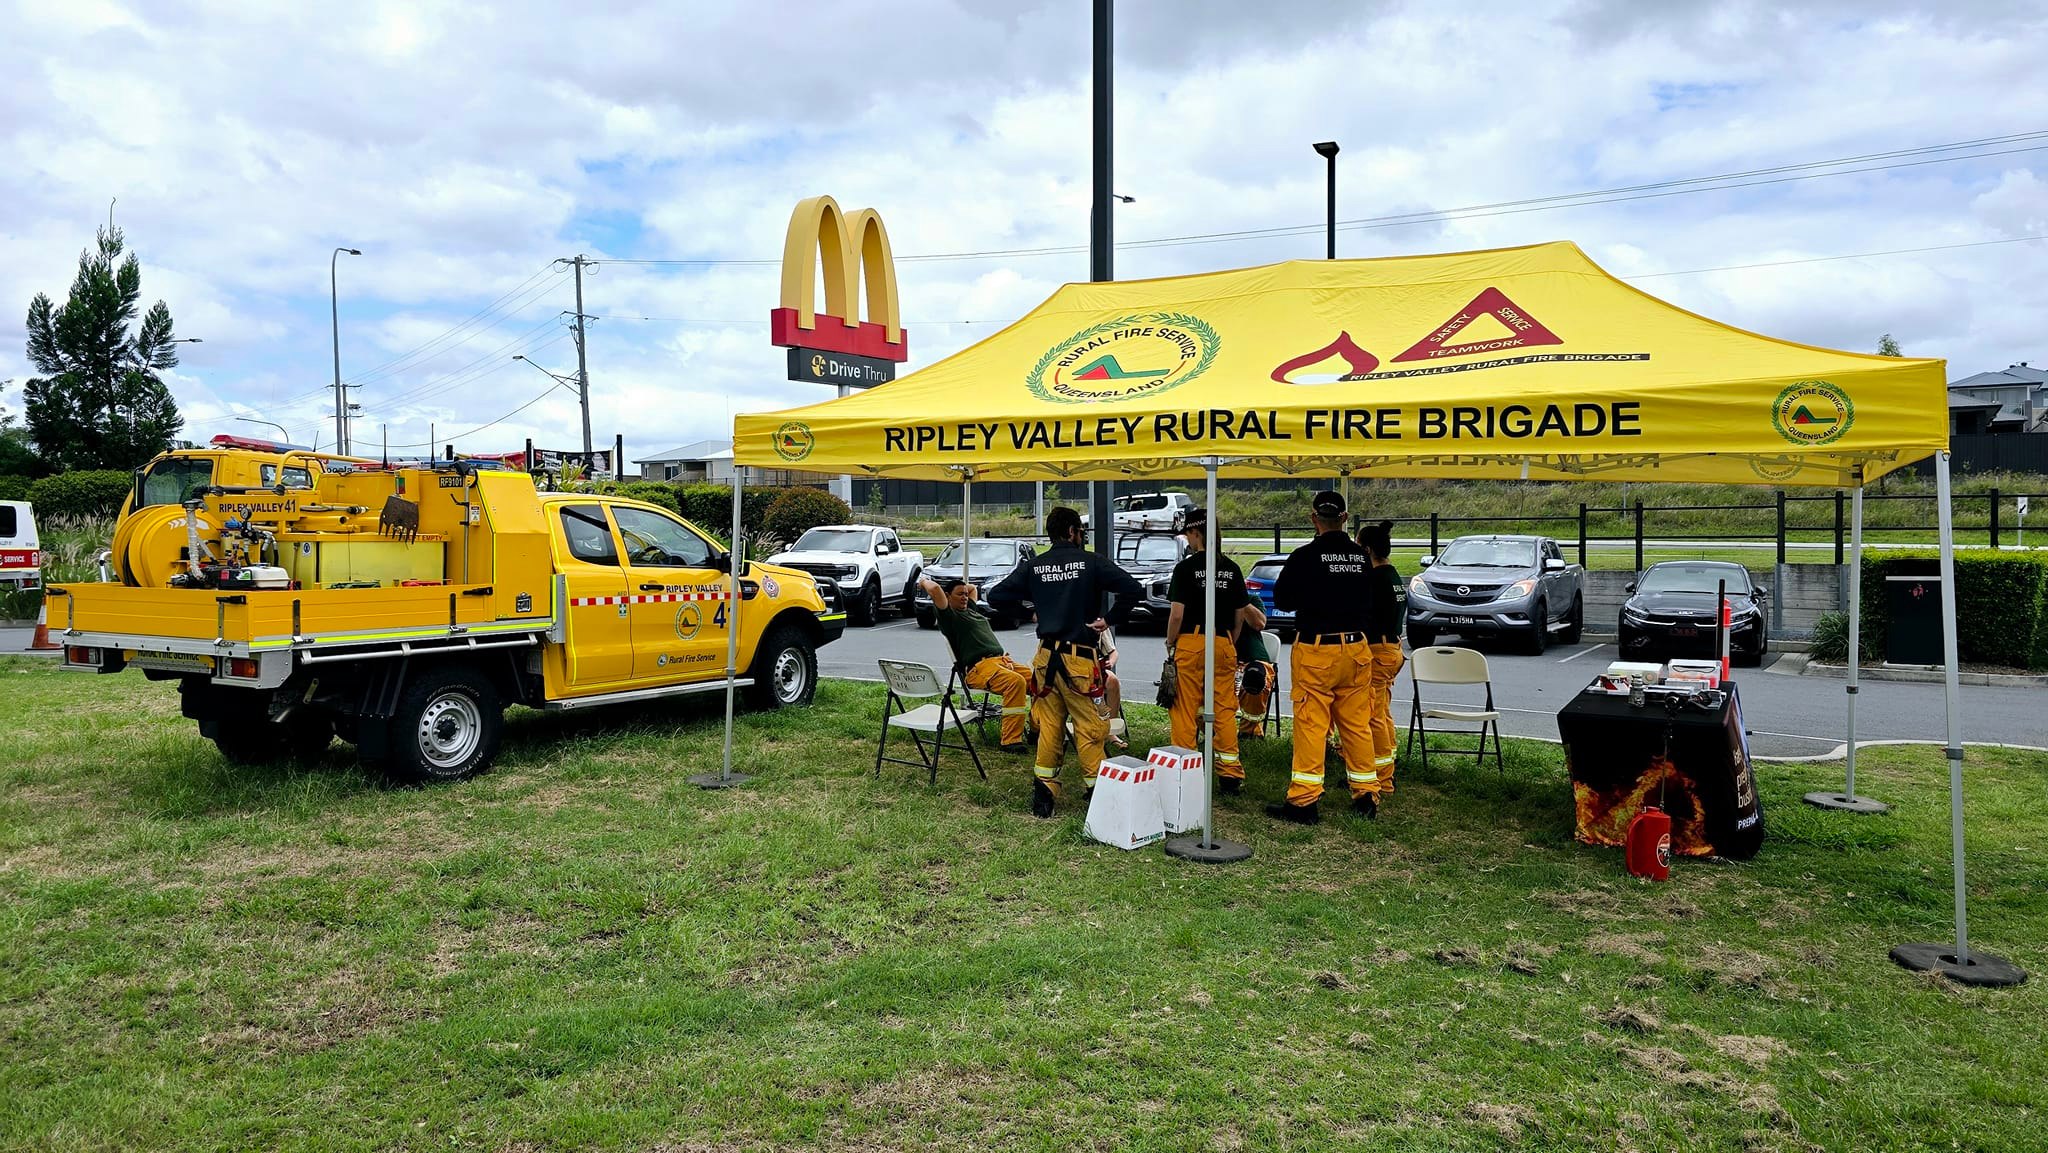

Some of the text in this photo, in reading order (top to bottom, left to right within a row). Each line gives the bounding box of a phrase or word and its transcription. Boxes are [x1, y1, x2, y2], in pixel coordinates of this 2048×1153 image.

[1496, 307, 1533, 332] SERVICE
[1430, 313, 1470, 344] SAFETY
[1058, 327, 1197, 368] RURAL FIRE SERVICE
[1428, 338, 1525, 358] TEAMWORK
[829, 360, 887, 382] Drive Thru
[1349, 353, 1642, 382] RIPLEY VALLEY RURAL FIRE BRIGADE
[1053, 378, 1165, 399] QUEENSLAND
[1781, 388, 1845, 415] RURAL FIRE SERVICE
[883, 401, 1643, 452] RIPLEY VALLEY RURAL FIRE BRIGADE
[1788, 425, 1838, 440] QUEENSLAND
[440, 477, 464, 487] RF9101
[250, 503, 284, 513] VALLEY
[284, 499, 297, 513] 41
[1321, 553, 1366, 564] RURAL FIRE
[1033, 561, 1086, 575] RURAL FIRE
[1217, 570, 1234, 580] FIRE
[1329, 564, 1363, 573] SERVICE
[1041, 570, 1079, 583] SERVICE
[666, 584, 723, 593] RIPLEY VALLEY
[1201, 579, 1228, 589] SVICE
[668, 653, 716, 665] Rural Fire Service
